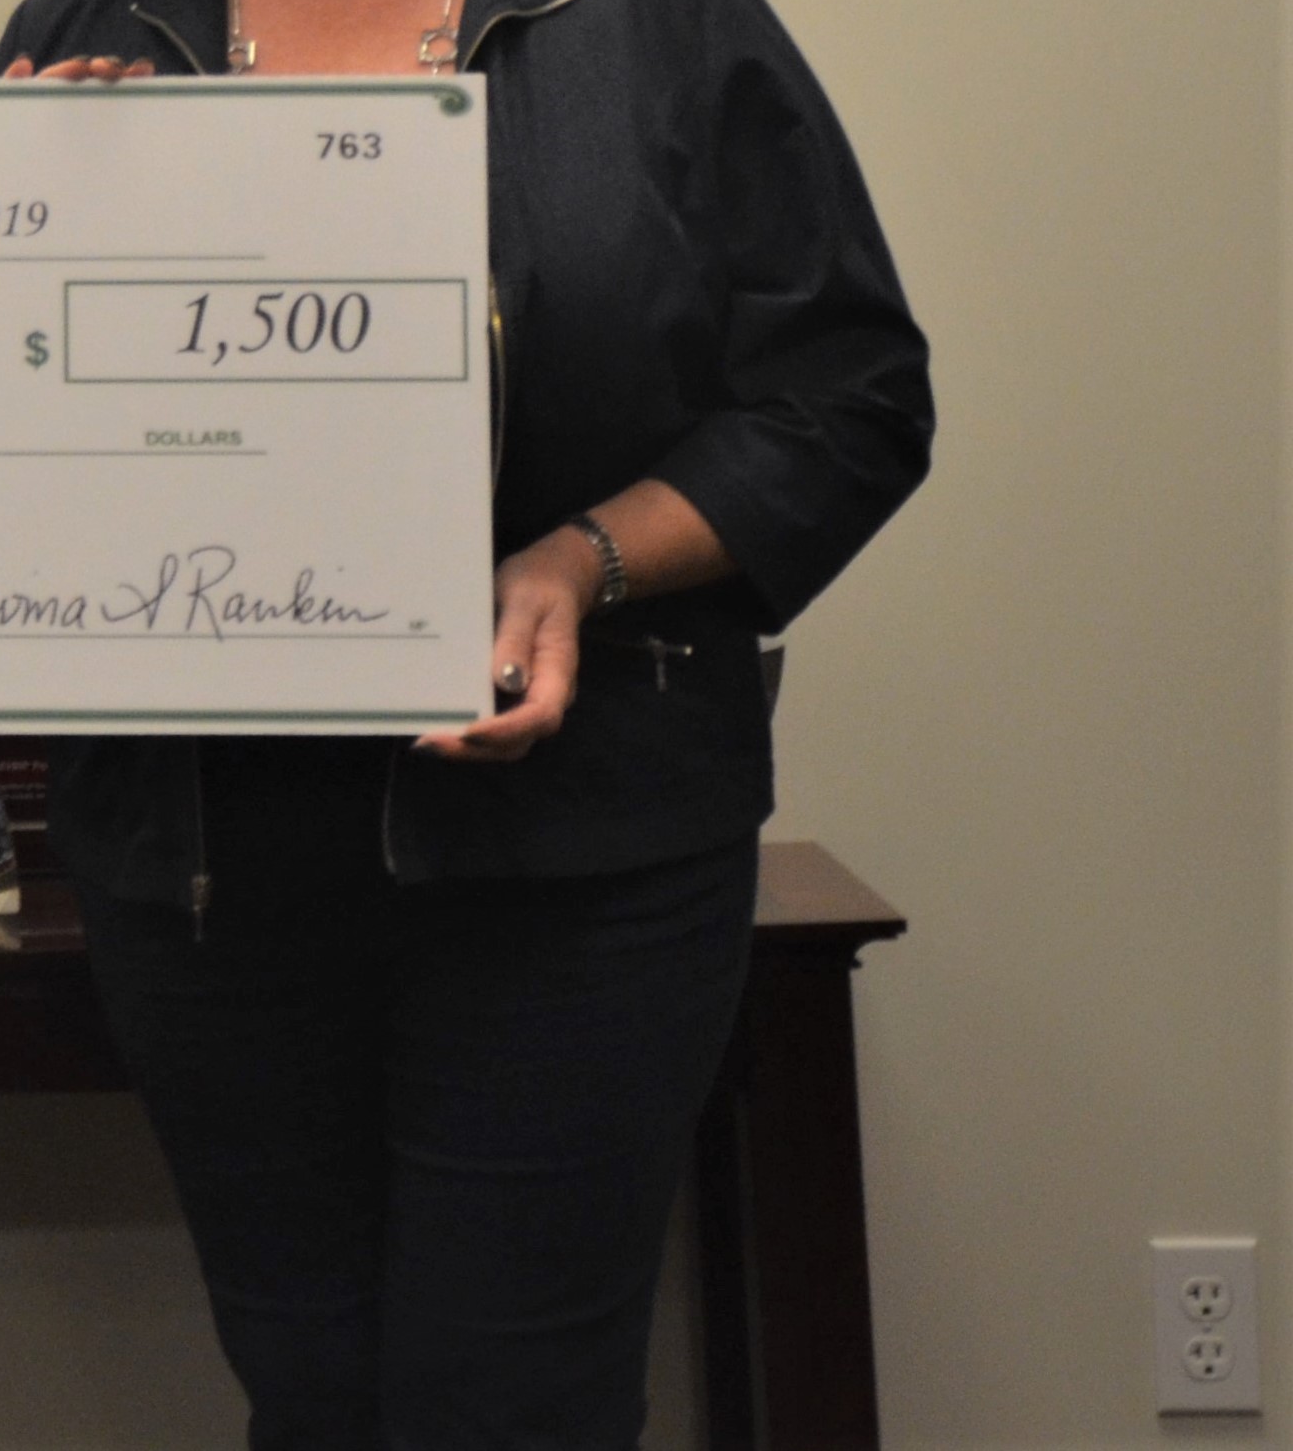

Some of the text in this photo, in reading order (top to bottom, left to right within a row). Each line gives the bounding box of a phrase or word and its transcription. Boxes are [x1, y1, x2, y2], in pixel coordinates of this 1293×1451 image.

[316, 133, 383, 160] 763
[24, 291, 372, 370] $ 1,500
[144, 429, 242, 447] DOLLARS
